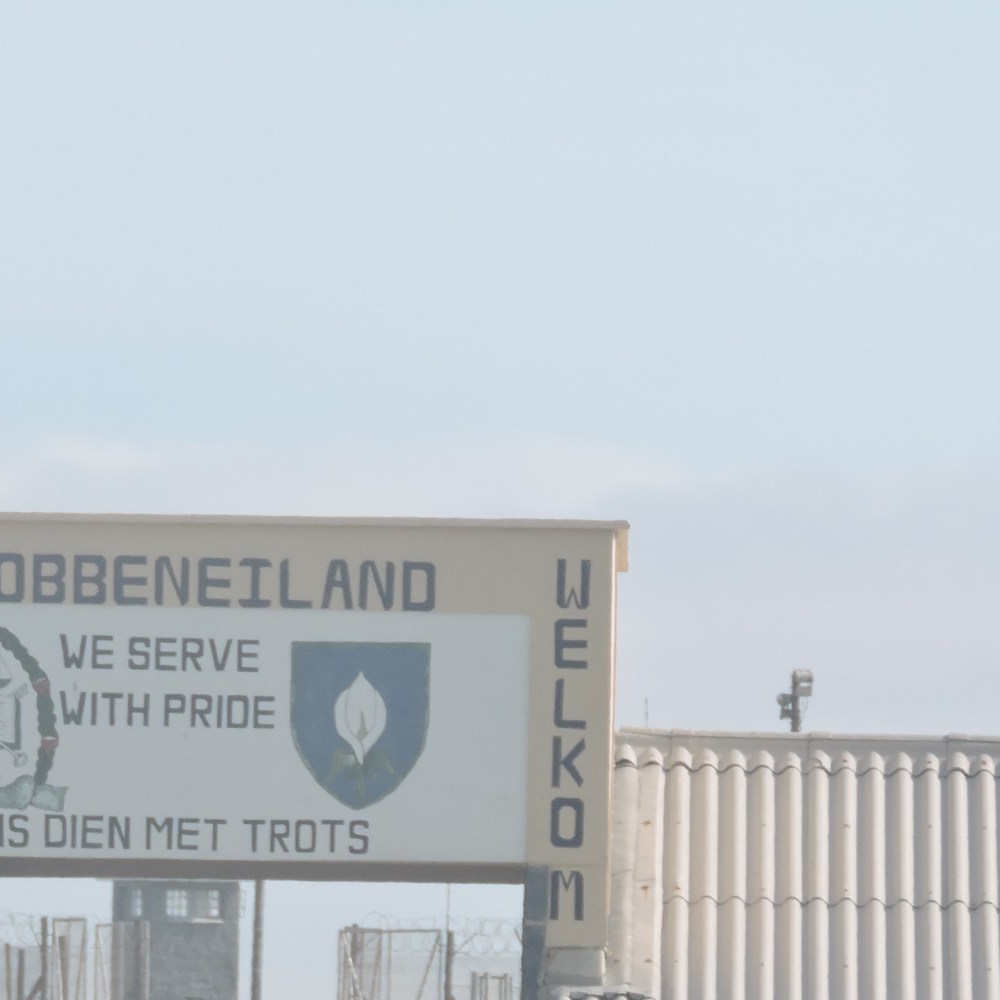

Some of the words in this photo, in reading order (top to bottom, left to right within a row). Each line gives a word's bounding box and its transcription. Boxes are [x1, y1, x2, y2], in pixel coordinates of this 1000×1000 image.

[60, 634, 114, 669] WE
[128, 636, 261, 673] SERVE
[60, 691, 151, 727] WITH
[162, 693, 275, 728] PRIDE
[549, 559, 591, 922] WELKOM
[43, 813, 131, 850] DIEN
[145, 816, 227, 852] MET
[243, 818, 369, 854] TROTS
